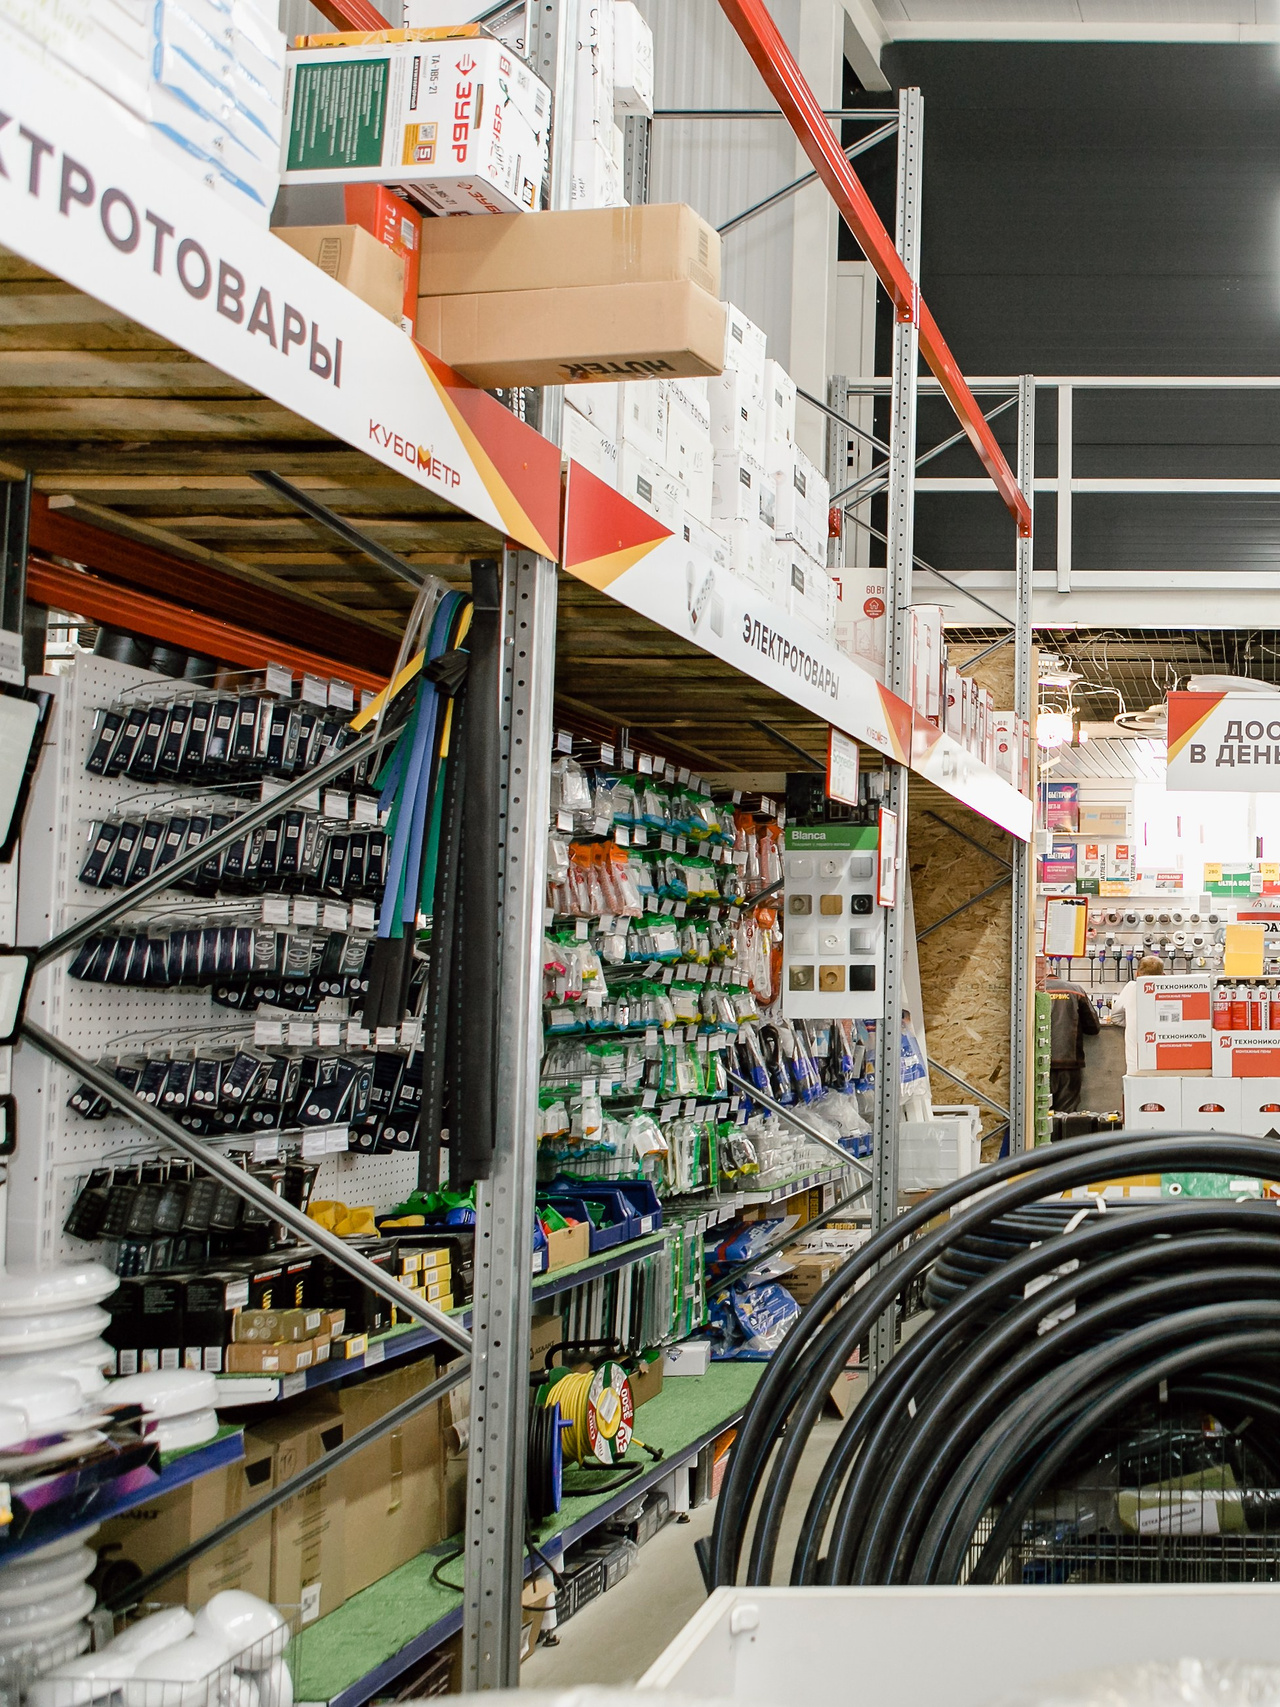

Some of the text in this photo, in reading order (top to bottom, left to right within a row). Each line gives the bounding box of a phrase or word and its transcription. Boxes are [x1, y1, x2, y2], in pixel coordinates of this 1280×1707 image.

[451, 82, 472, 163] ЗУБР
[369, 418, 462, 489] КУБОМЕТР
[742, 613, 840, 701] ЭЛЕКТРОТОВАРЫ
[1190, 744, 1206, 764] В
[791, 831, 826, 840] Blanca
[810, 1198, 819, 1219] DENZE
